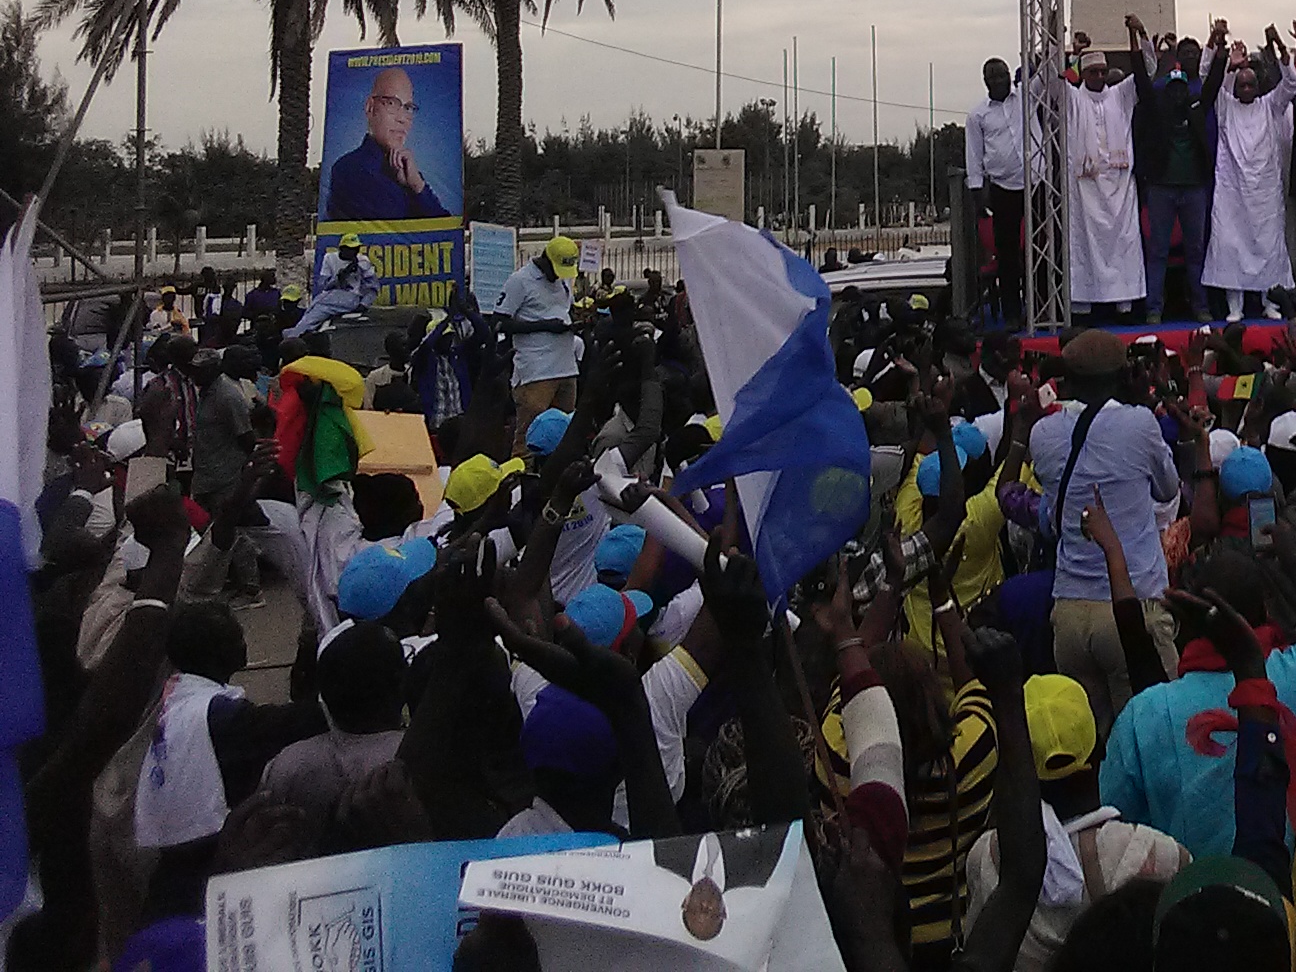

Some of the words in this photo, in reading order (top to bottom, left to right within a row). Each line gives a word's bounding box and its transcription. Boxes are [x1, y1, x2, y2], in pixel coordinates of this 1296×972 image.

[326, 241, 454, 279] SIDENT
[492, 868, 532, 882] GUIS
[536, 873, 575, 889] GUIS
[476, 887, 538, 904] LIBERALE
[580, 880, 626, 897] BOKK
[540, 896, 631, 918] CONVERGENCE
[362, 906, 375, 941] GIS
